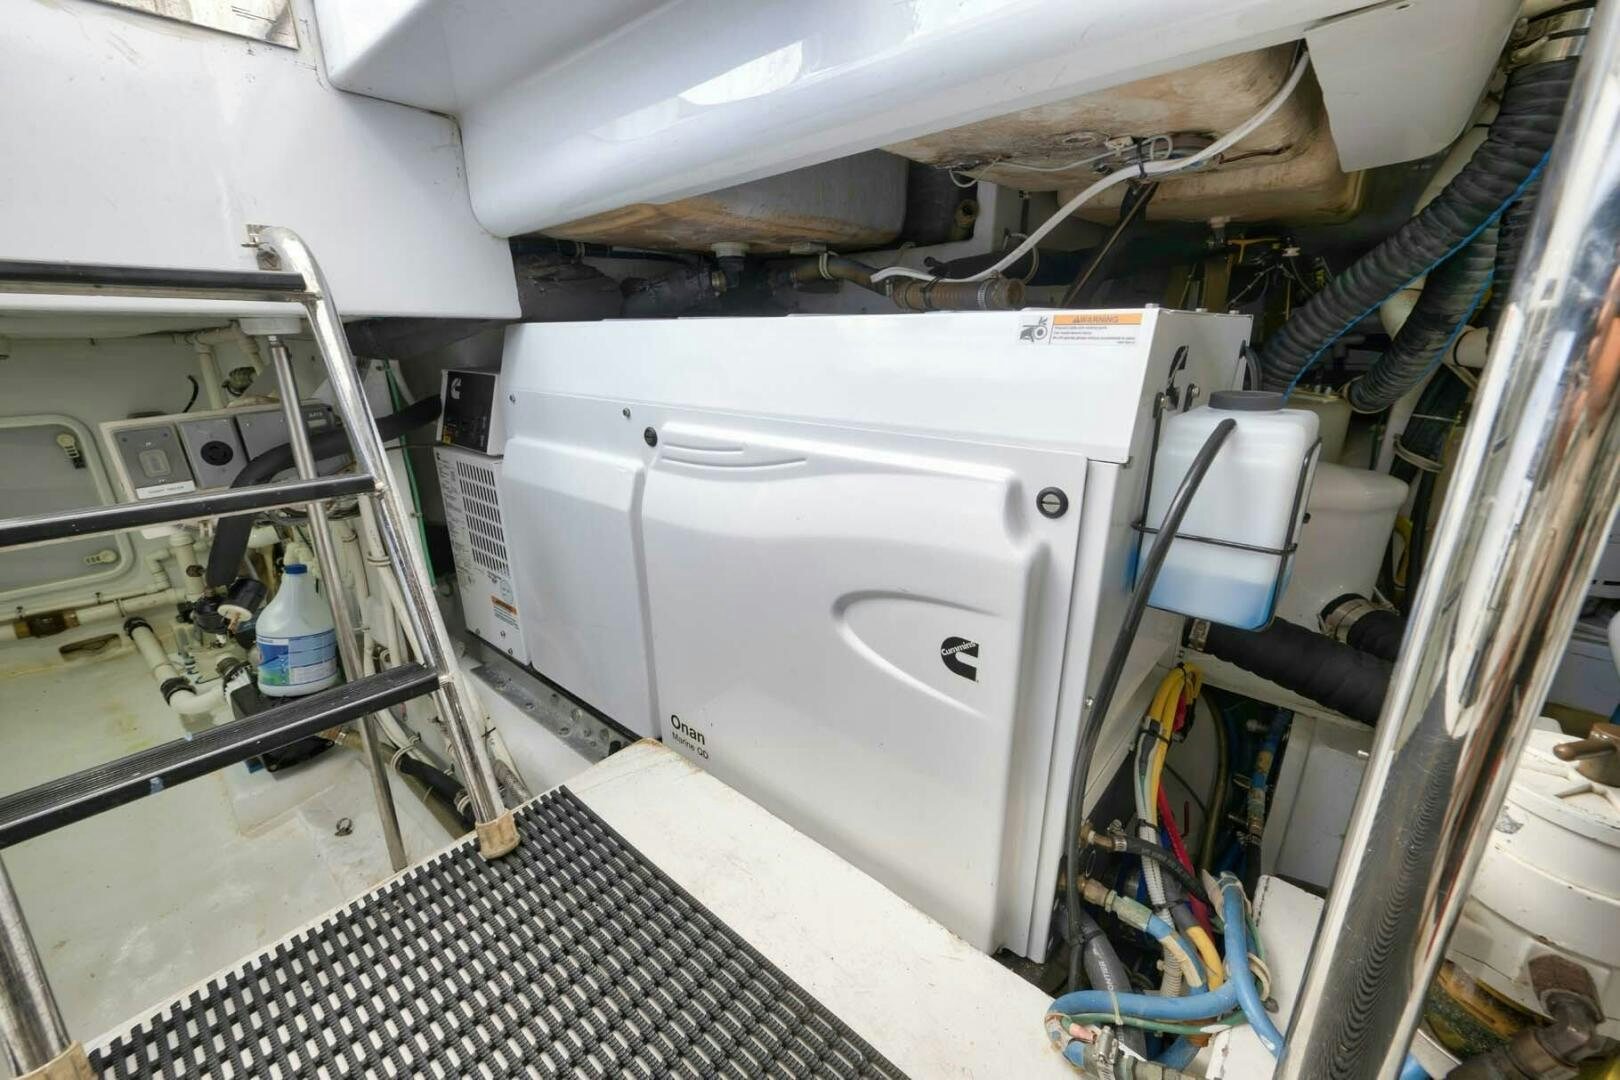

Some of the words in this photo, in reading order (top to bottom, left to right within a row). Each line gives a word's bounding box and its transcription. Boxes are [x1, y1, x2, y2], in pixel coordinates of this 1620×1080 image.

[1079, 314, 1119, 323] WARNING
[941, 641, 976, 656] Cummins
[671, 714, 705, 745] Onan
[672, 731, 695, 751] Marine
